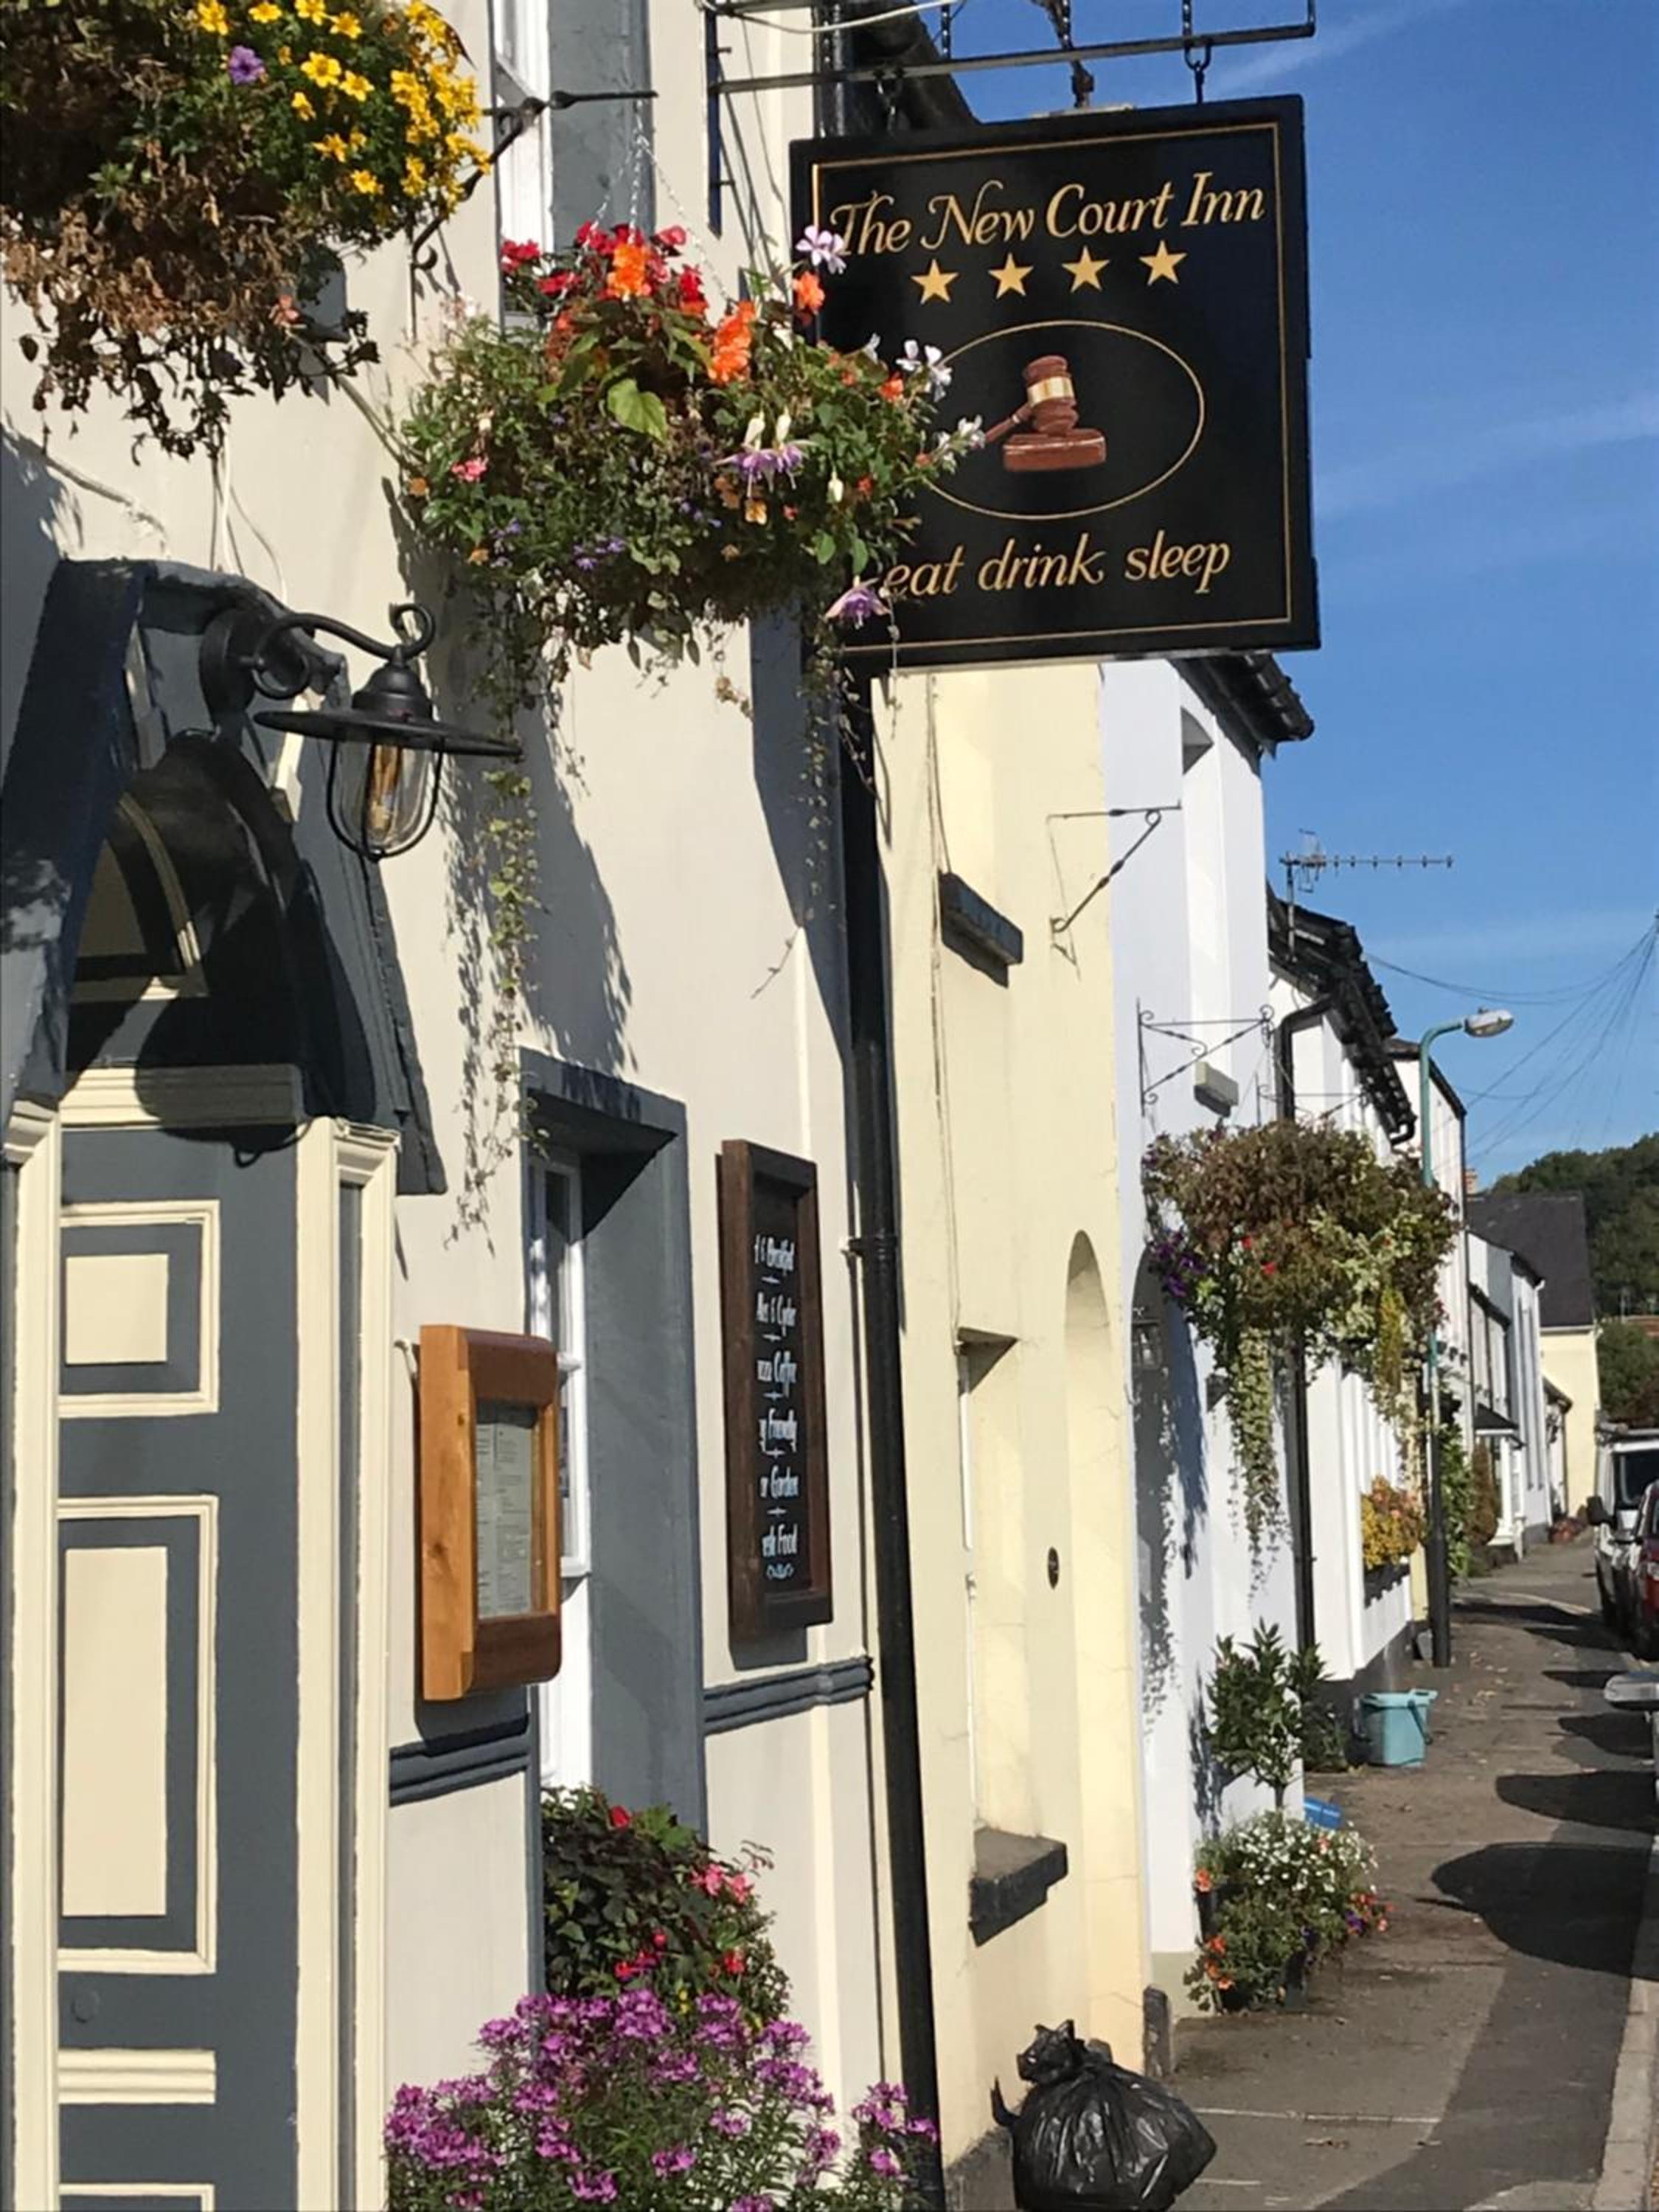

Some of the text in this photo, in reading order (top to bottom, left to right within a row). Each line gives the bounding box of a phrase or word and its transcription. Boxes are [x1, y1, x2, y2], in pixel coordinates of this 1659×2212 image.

[830, 170, 1265, 256] The New Court Inn
[883, 529, 1230, 597] eat drink sleep
